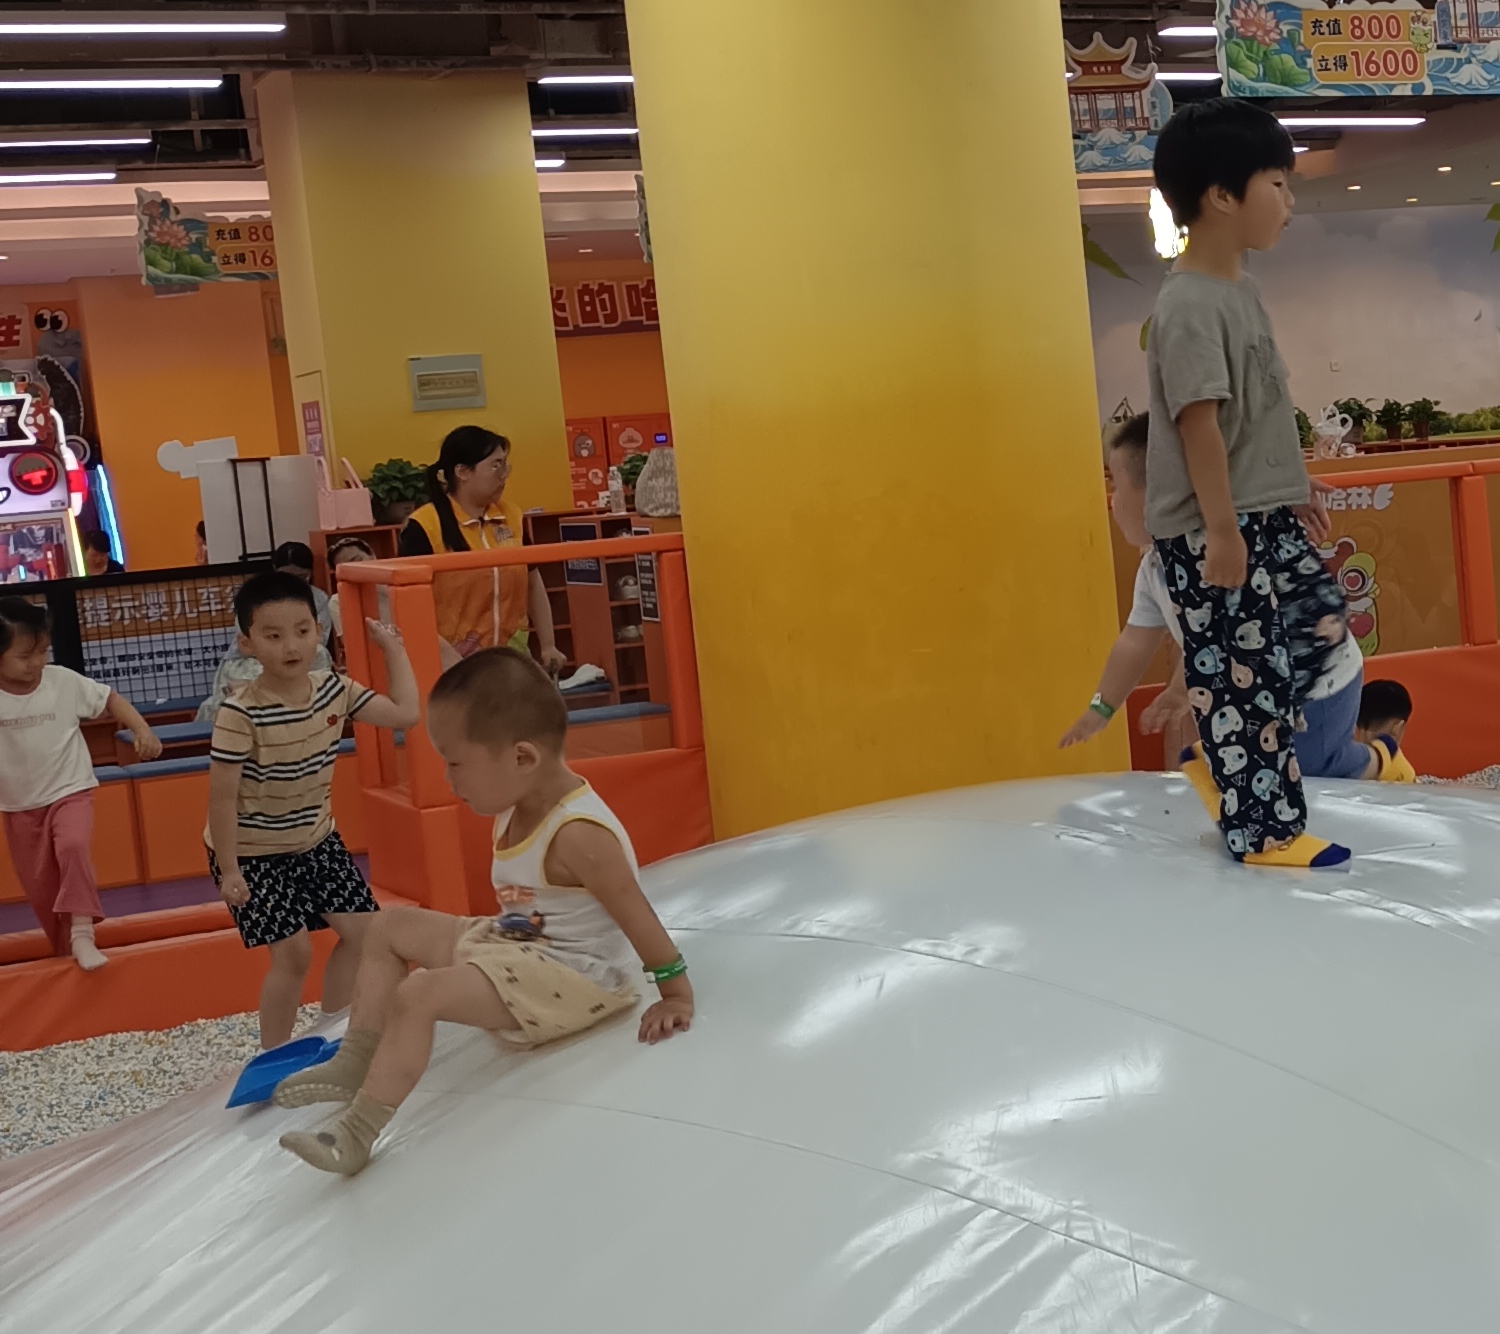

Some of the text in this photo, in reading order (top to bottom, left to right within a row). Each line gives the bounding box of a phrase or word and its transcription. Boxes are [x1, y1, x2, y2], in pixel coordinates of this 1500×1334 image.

[1310, 14, 1402, 42] 充值 800
[1316, 49, 1419, 79] 立得 1600
